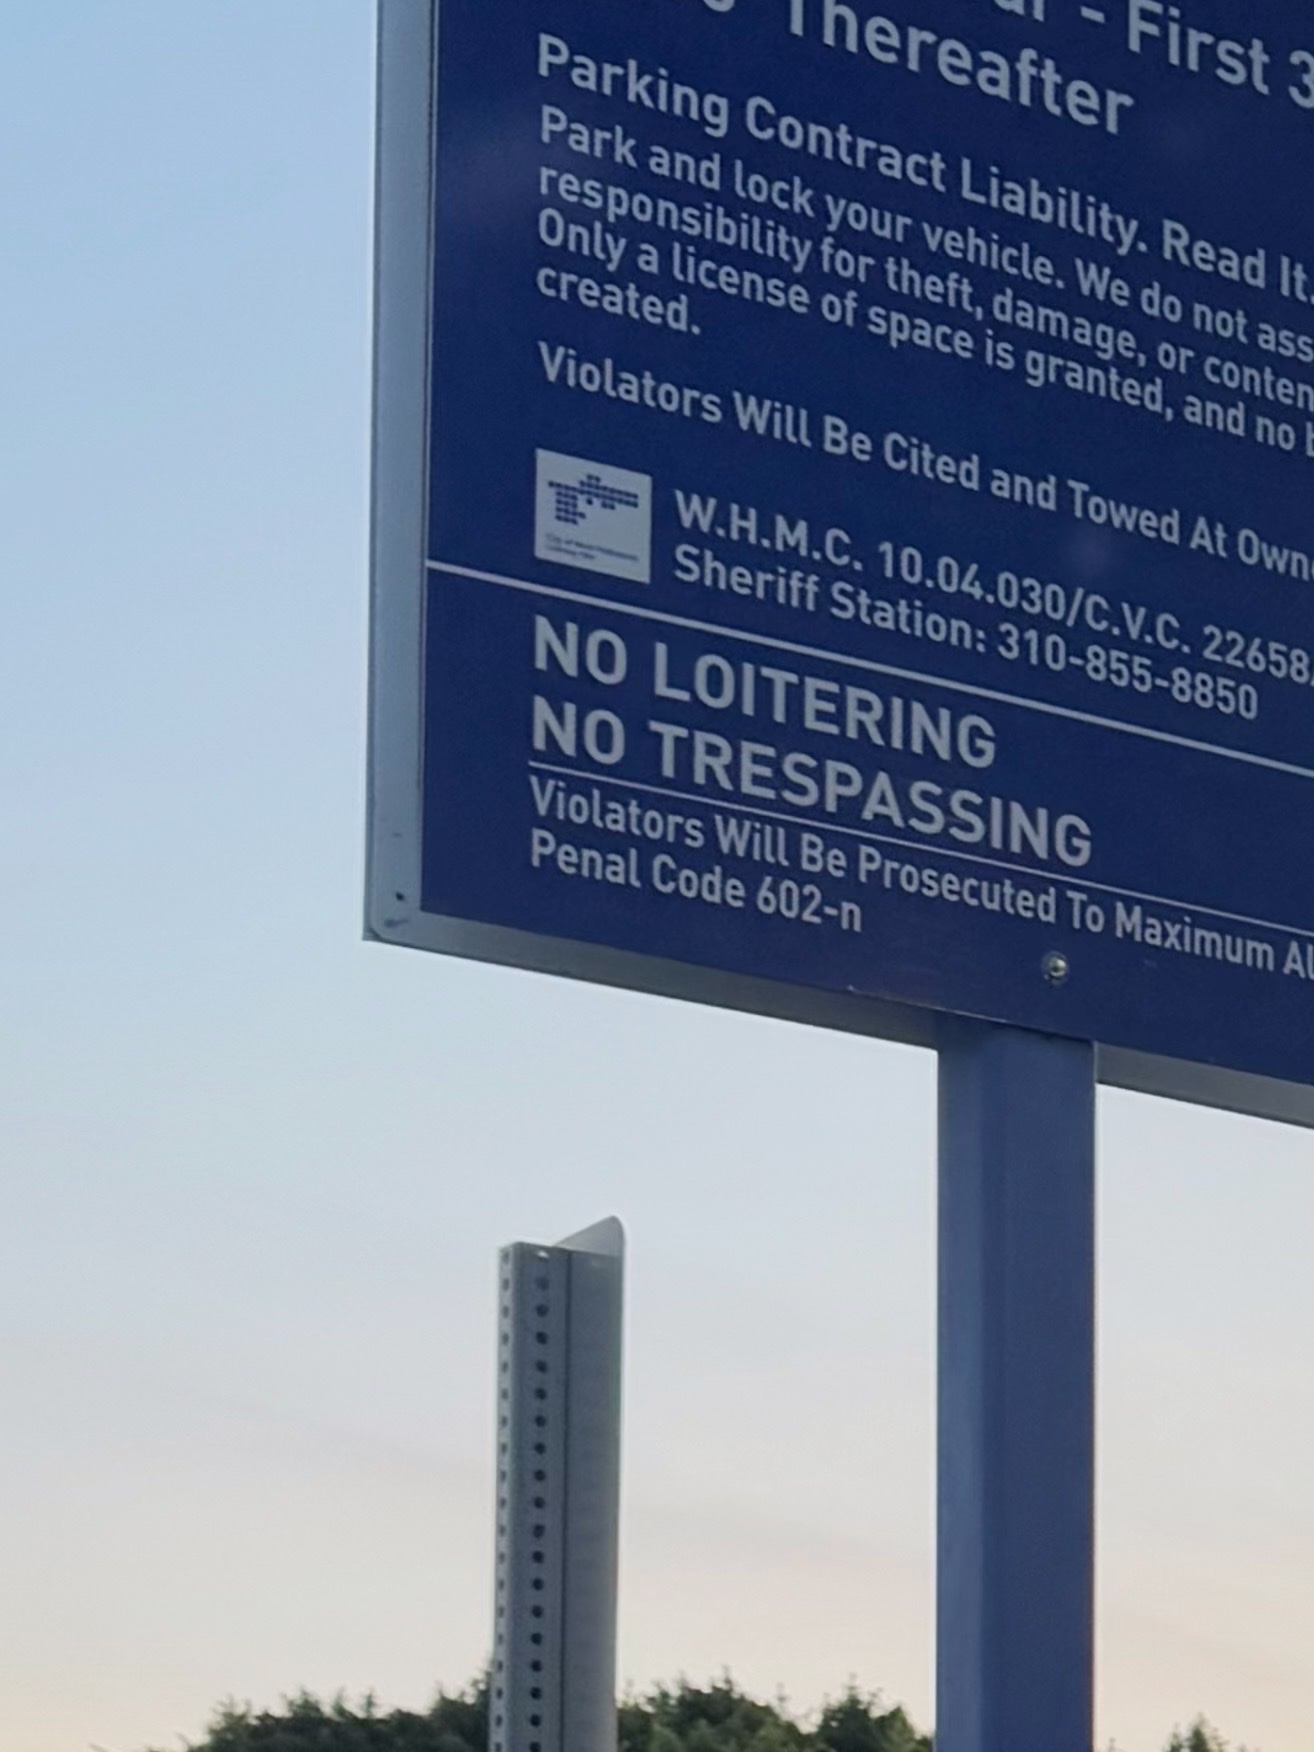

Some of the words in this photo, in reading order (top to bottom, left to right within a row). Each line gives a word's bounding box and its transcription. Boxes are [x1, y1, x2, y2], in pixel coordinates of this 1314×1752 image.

[1128, 0, 1270, 95] First
[537, 32, 730, 139] Parking
[745, 95, 947, 193] Contract
[960, 156, 1148, 257] Liability.
[1162, 218, 1267, 290] Read
[540, 103, 638, 169] Park
[647, 144, 721, 192] and
[734, 158, 816, 218] lock
[823, 193, 914, 243] your
[921, 221, 1066, 290] vehicle.
[1074, 257, 1131, 308] We
[1139, 280, 1183, 324] do
[1192, 301, 1249, 345] not
[535, 266, 702, 336] created.
[538, 206, 628, 273] Only
[636, 242, 660, 276] a
[672, 240, 811, 314] license
[820, 289, 859, 328] of
[866, 305, 975, 359] space
[984, 336, 1016, 371] is
[1024, 349, 1174, 423] granted,
[1182, 394, 1246, 438] and
[1255, 415, 1296, 451] no
[539, 165, 813, 274] responsibility
[819, 235, 877, 284] for
[882, 255, 983, 321] theft,
[992, 284, 1148, 369] damage,
[1156, 341, 1196, 375] or
[537, 340, 723, 424] Violators
[732, 390, 813, 448] Will
[822, 414, 873, 462] Be
[883, 431, 980, 492] Cited
[989, 468, 1057, 512] and
[1066, 478, 1180, 546] Towed
[1188, 515, 1228, 559] At
[673, 543, 821, 612] Sheriff
[829, 580, 987, 654] Station:
[996, 621, 1259, 721] 310-855-8850
[674, 488, 864, 572] W.H.M.C.
[877, 540, 1192, 655] 10.04.030/C.V.C.
[534, 614, 628, 686] NO
[653, 641, 996, 769] LOITERING
[532, 694, 626, 766] NO
[647, 719, 1092, 868] TRESPASSING
[528, 775, 705, 850] Violators
[714, 814, 792, 868] Will
[799, 831, 848, 879] Be
[856, 842, 1059, 927] Prosecuted
[1065, 889, 1106, 934] To
[1113, 905, 1276, 972] Maximum
[530, 826, 643, 889] Penal
[651, 853, 747, 909] Code
[755, 875, 862, 933] 602-n
